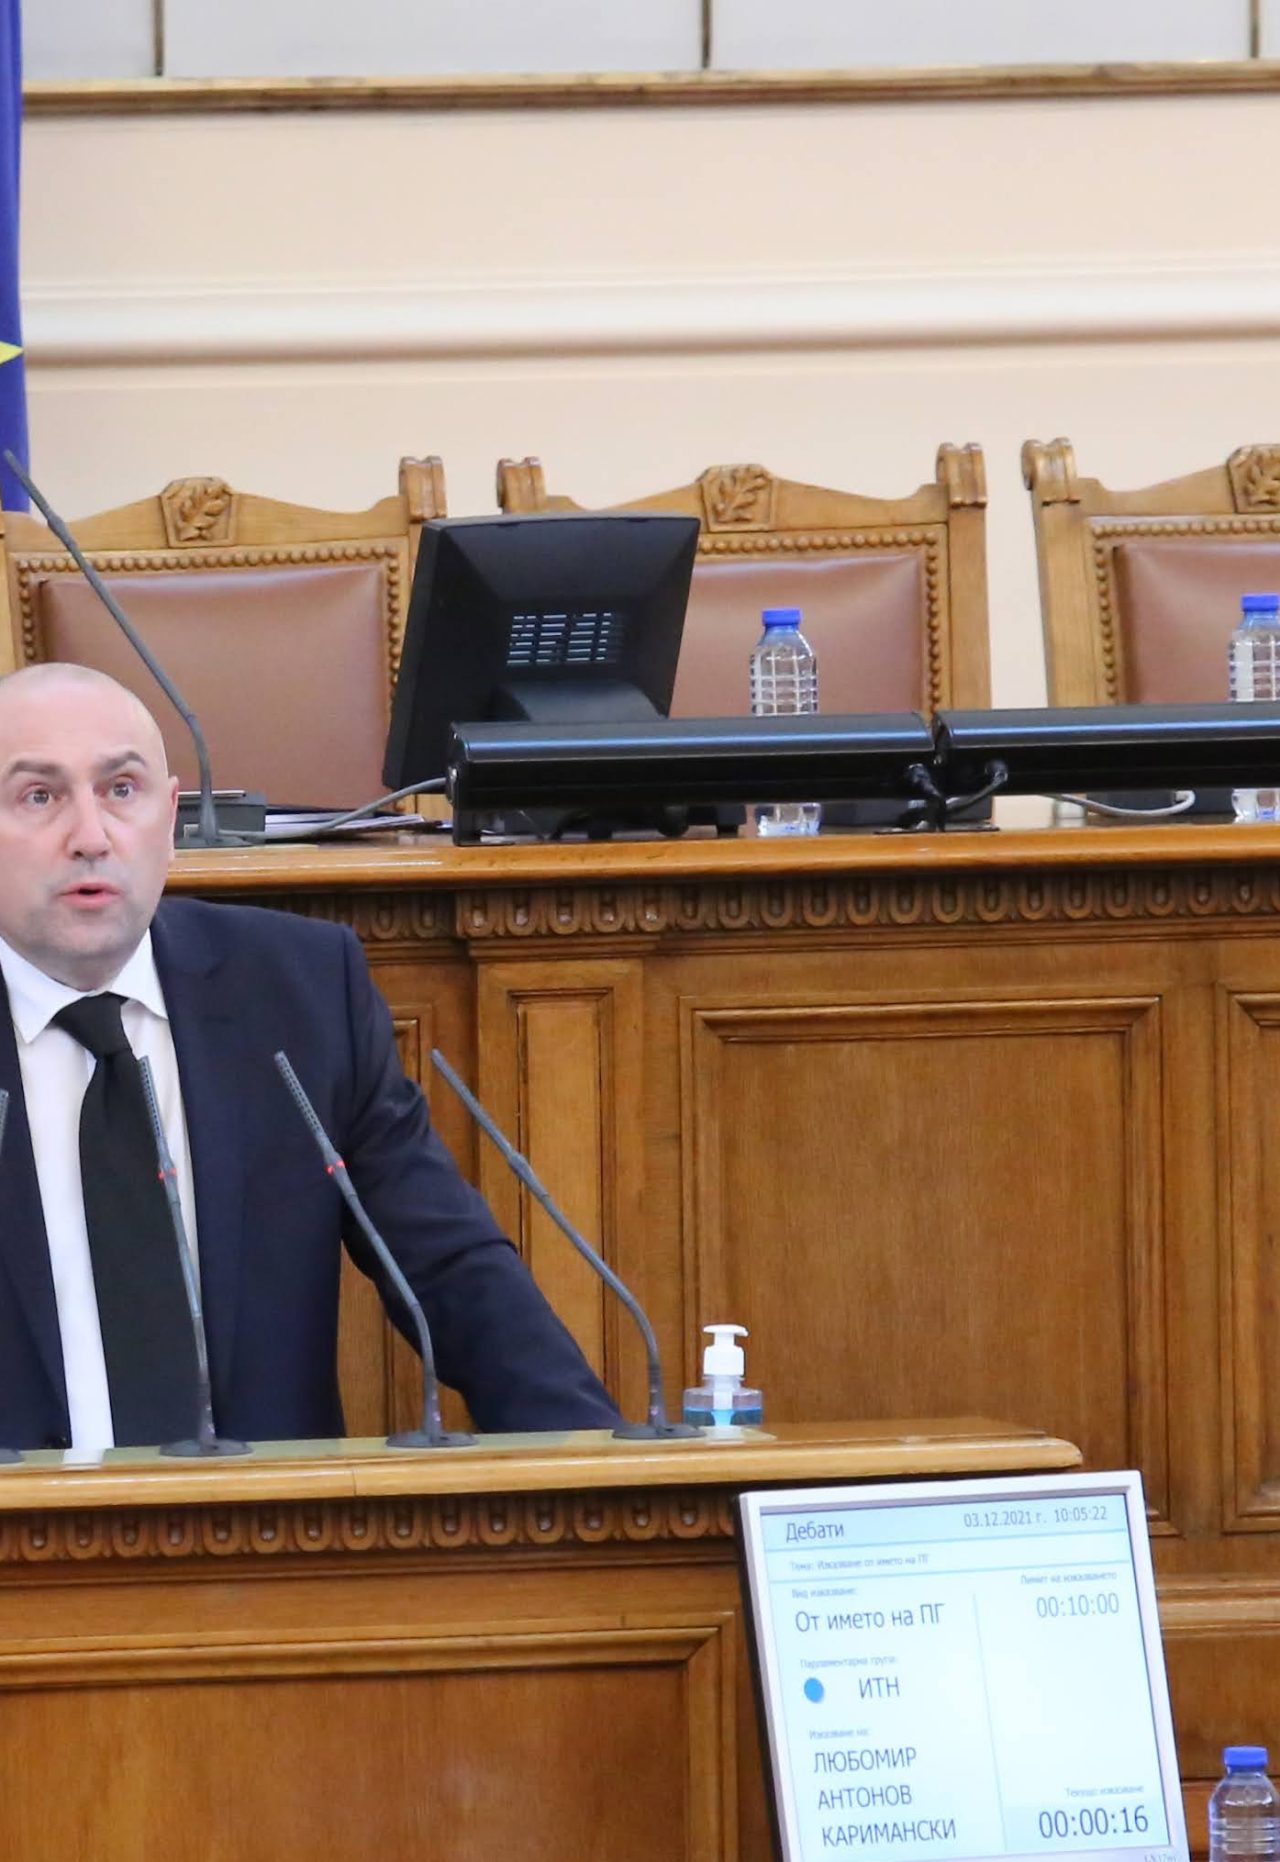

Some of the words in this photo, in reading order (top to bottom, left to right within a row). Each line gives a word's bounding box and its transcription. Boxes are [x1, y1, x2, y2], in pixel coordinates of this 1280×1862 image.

[963, 1510, 1033, 1528] 03.12.2021
[1054, 1506, 1108, 1523] 10:05:22
[786, 1521, 845, 1543] Дебати
[795, 1610, 820, 1633] От
[827, 1610, 885, 1630] името
[891, 1608, 914, 1627] на
[920, 1603, 945, 1625] ПГ
[1036, 1592, 1120, 1618] 00:10:00
[858, 1676, 901, 1700] ИТН
[814, 1747, 918, 1774] ЛЮБОМИР
[818, 1785, 913, 1811] АНТОНОВ
[822, 1819, 957, 1848] КАРИМАНСКИ
[1038, 1805, 1150, 1839] 00:00:16
